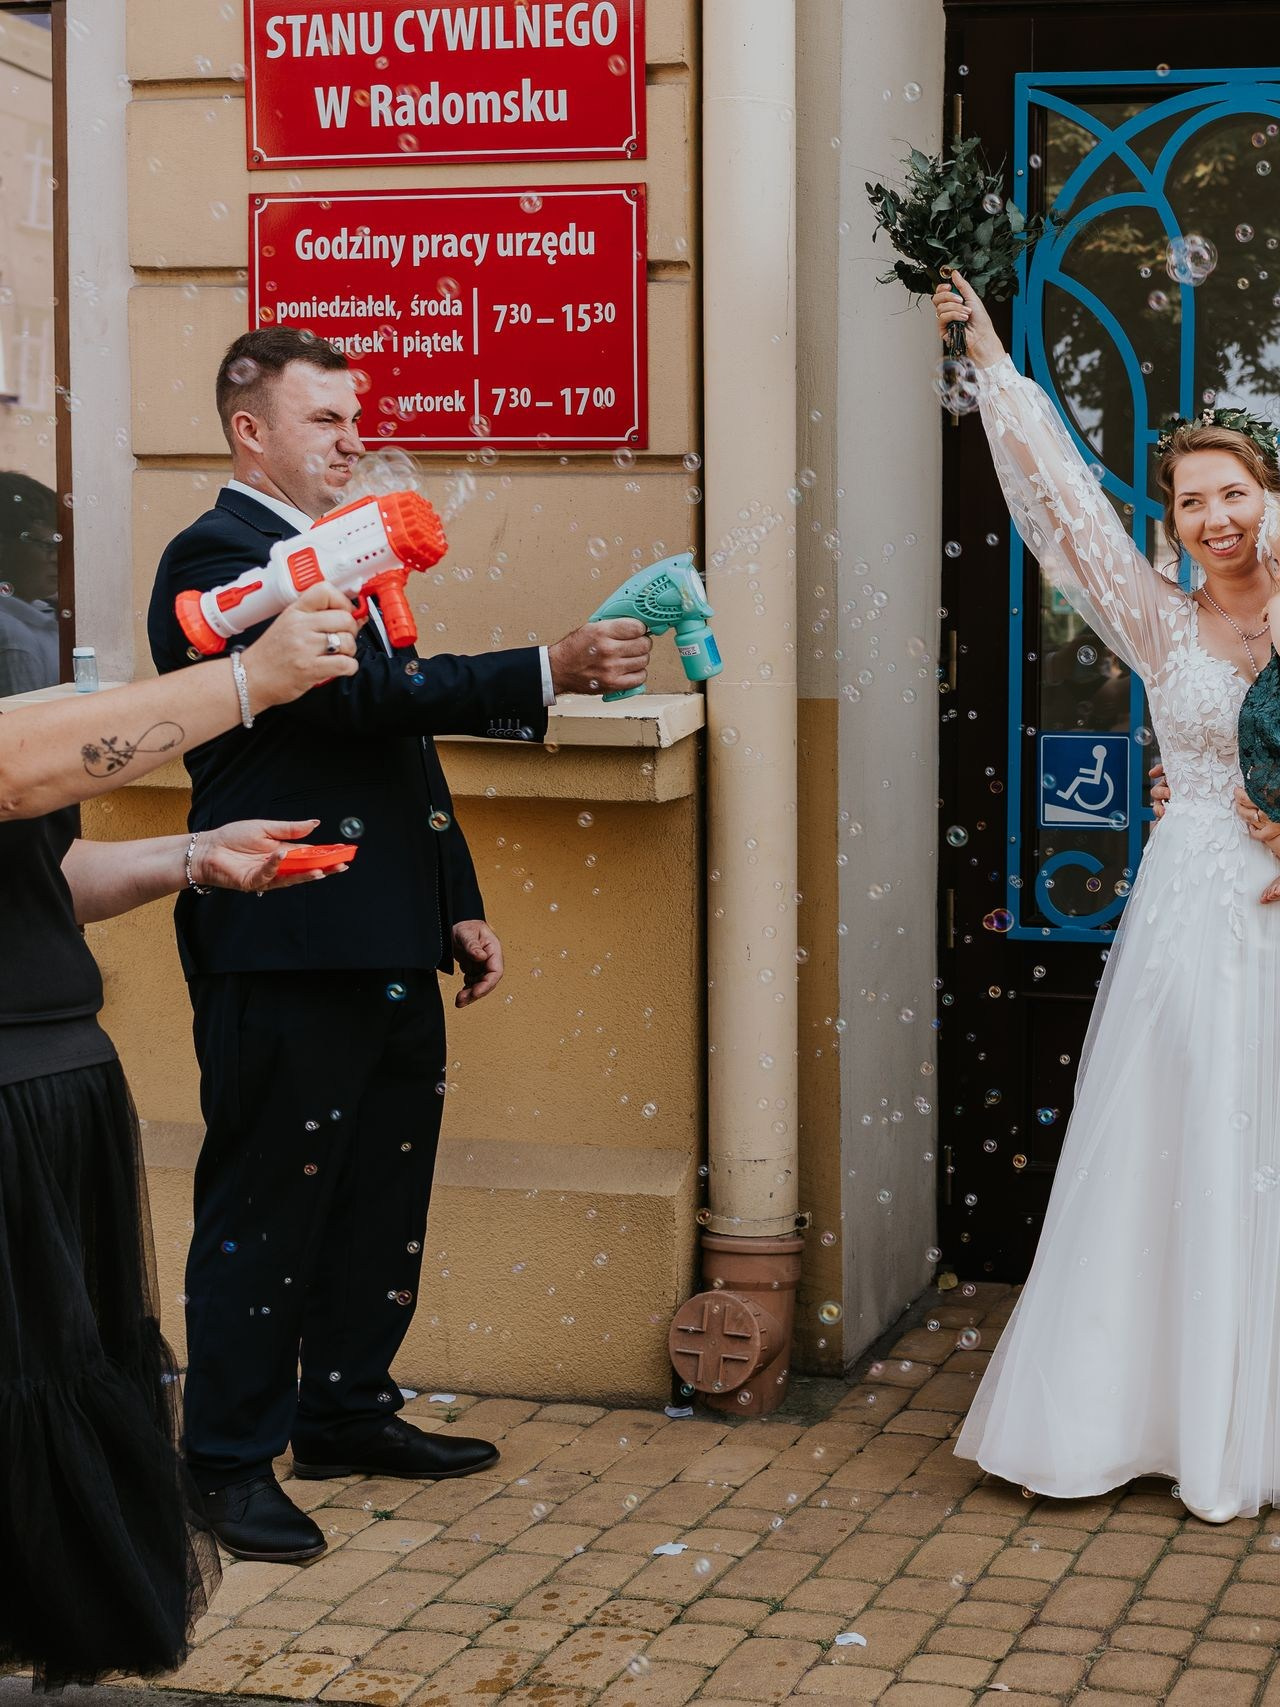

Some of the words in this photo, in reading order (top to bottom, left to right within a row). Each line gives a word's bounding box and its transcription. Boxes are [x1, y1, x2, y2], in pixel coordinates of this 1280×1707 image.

[266, 11, 384, 60] STANU
[393, 2, 618, 54] CYWILNEGO
[314, 85, 351, 129] W
[370, 78, 568, 127] Radomsku
[295, 227, 406, 268] Godziny
[412, 230, 489, 266] pracy
[496, 222, 595, 265] urzędu
[276, 295, 402, 323] poniedziałek,
[410, 294, 463, 317] środa
[324, 331, 385, 354] artek
[392, 331, 398, 353] i
[403, 329, 464, 358] piątek
[397, 390, 466, 413] wtorek
